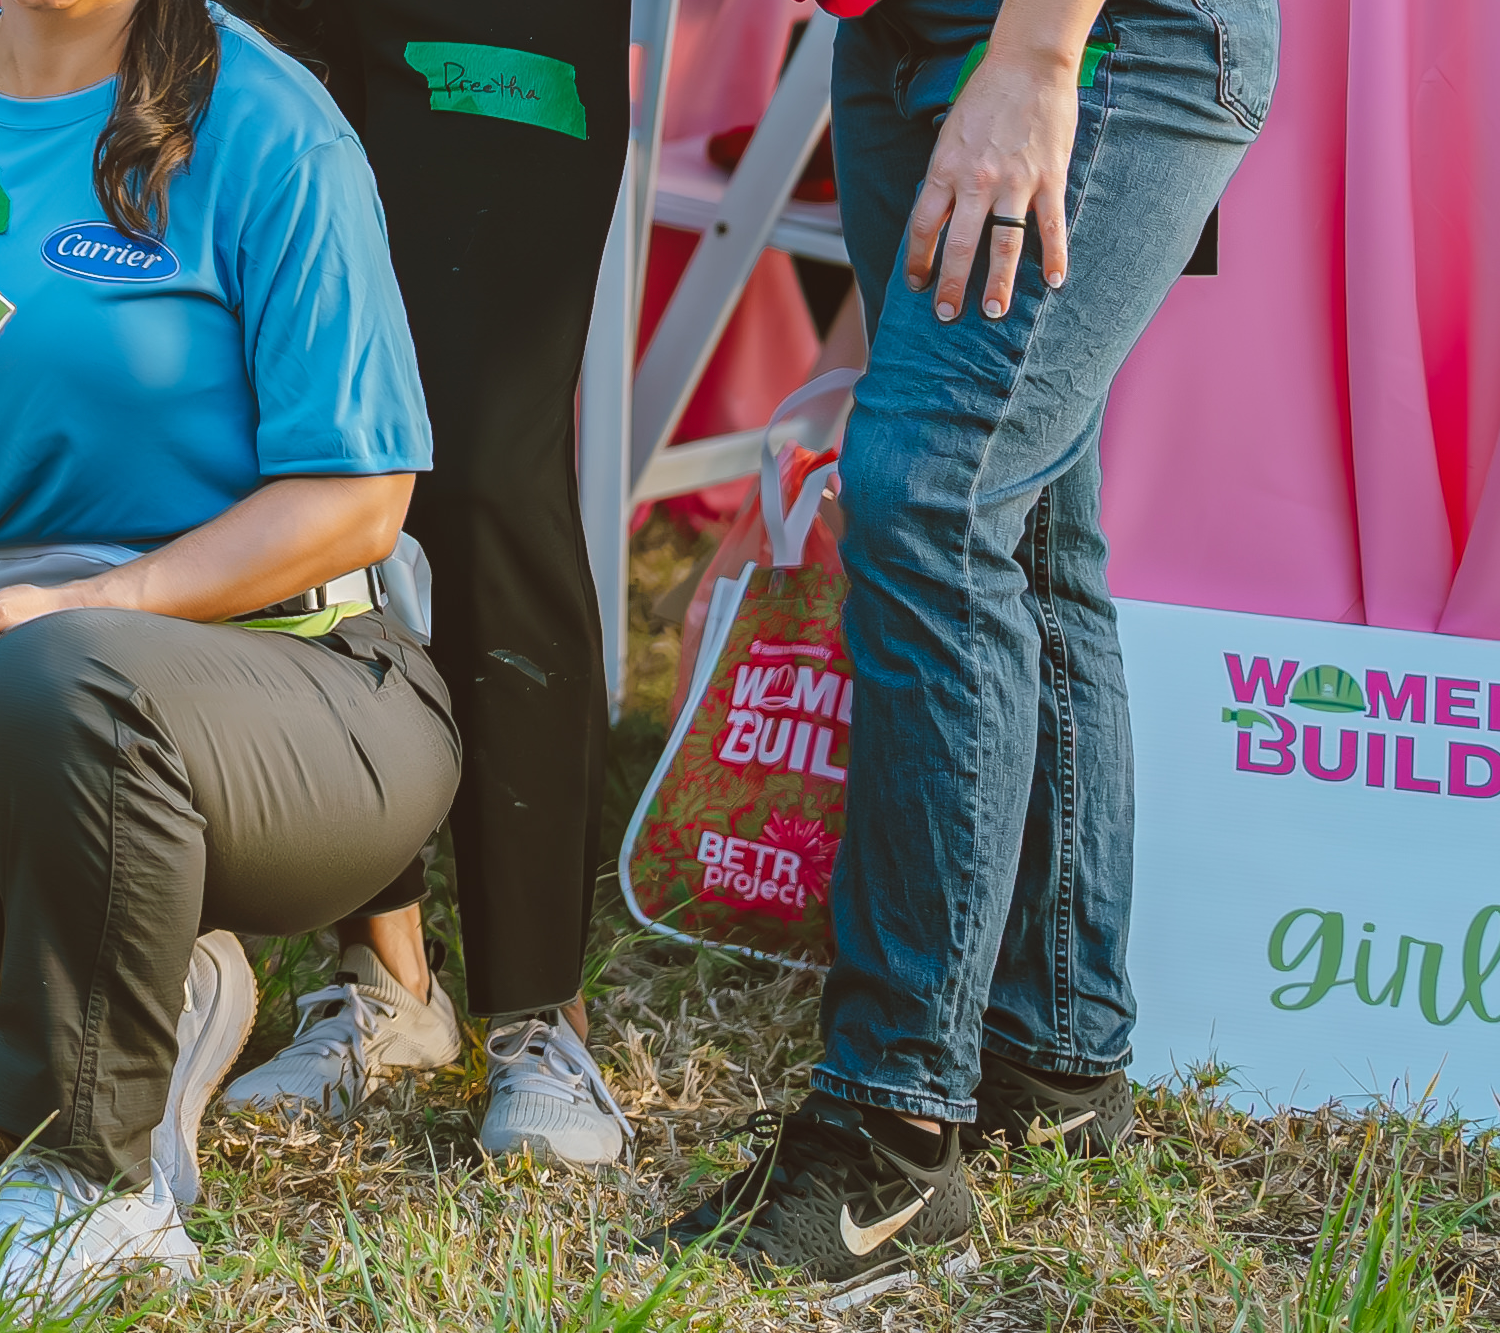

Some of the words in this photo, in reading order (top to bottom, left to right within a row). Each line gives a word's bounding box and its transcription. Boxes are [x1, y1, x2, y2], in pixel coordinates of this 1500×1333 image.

[443, 61, 541, 101] Preetha
[56, 233, 163, 271] Carrier
[719, 707, 846, 782] BUIL
[697, 829, 801, 886] BETR
[702, 863, 807, 909] project
